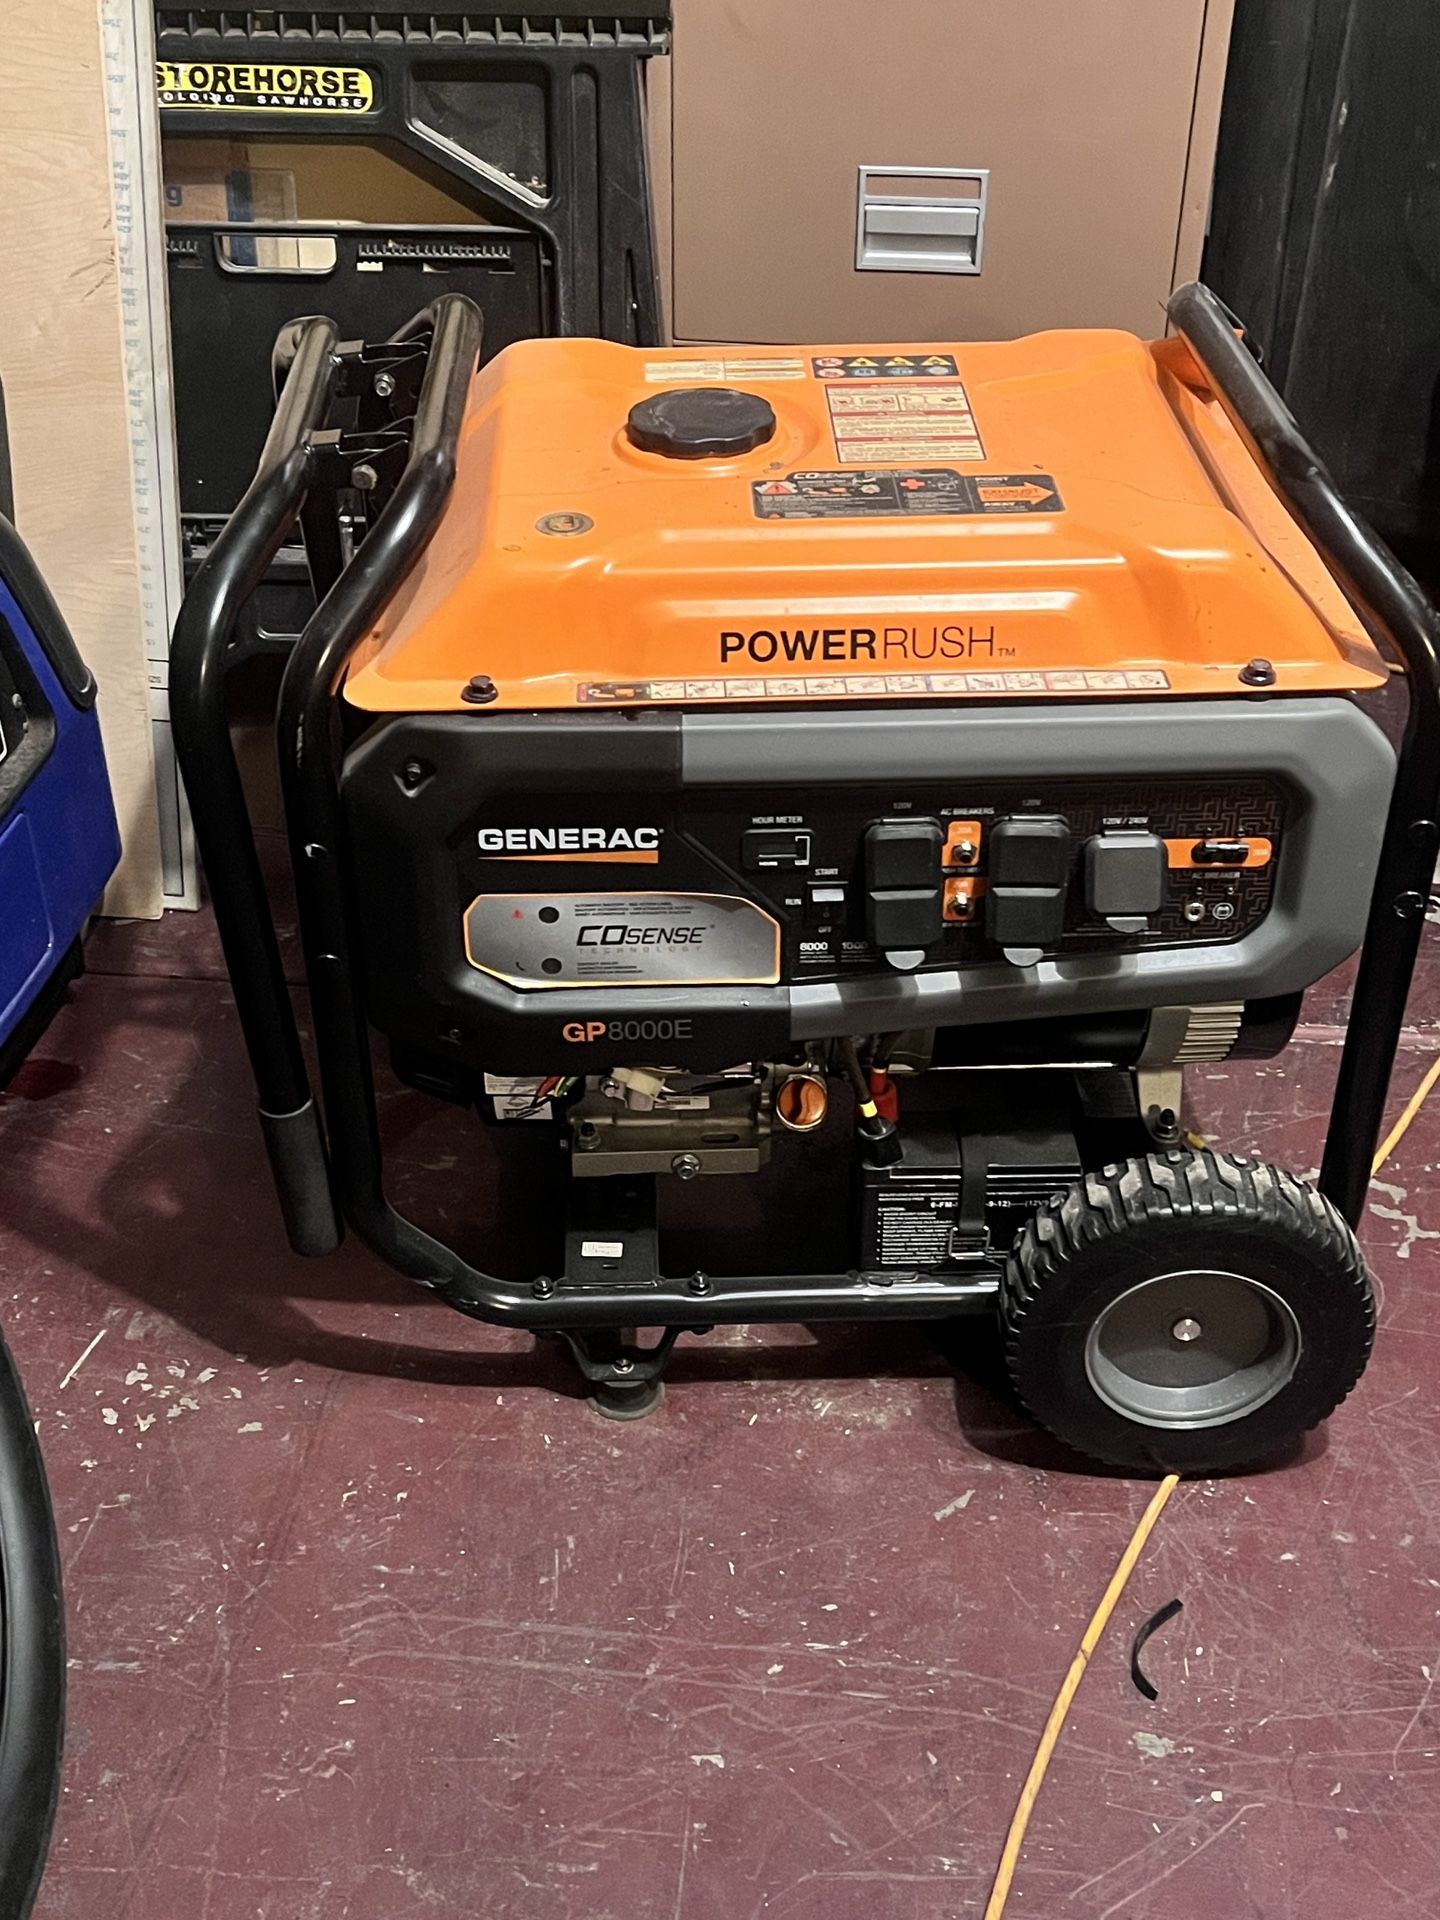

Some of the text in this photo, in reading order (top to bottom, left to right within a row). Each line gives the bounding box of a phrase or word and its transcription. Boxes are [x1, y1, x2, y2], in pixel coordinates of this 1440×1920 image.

[156, 64, 361, 97] STOREHORSE
[157, 91, 363, 107] OLDING SAWHORSE
[752, 815, 803, 824] HOUR METER
[478, 827, 659, 850] GENERAC
[576, 925, 707, 946] COSENSE
[562, 1019, 693, 1042] GP8000E
